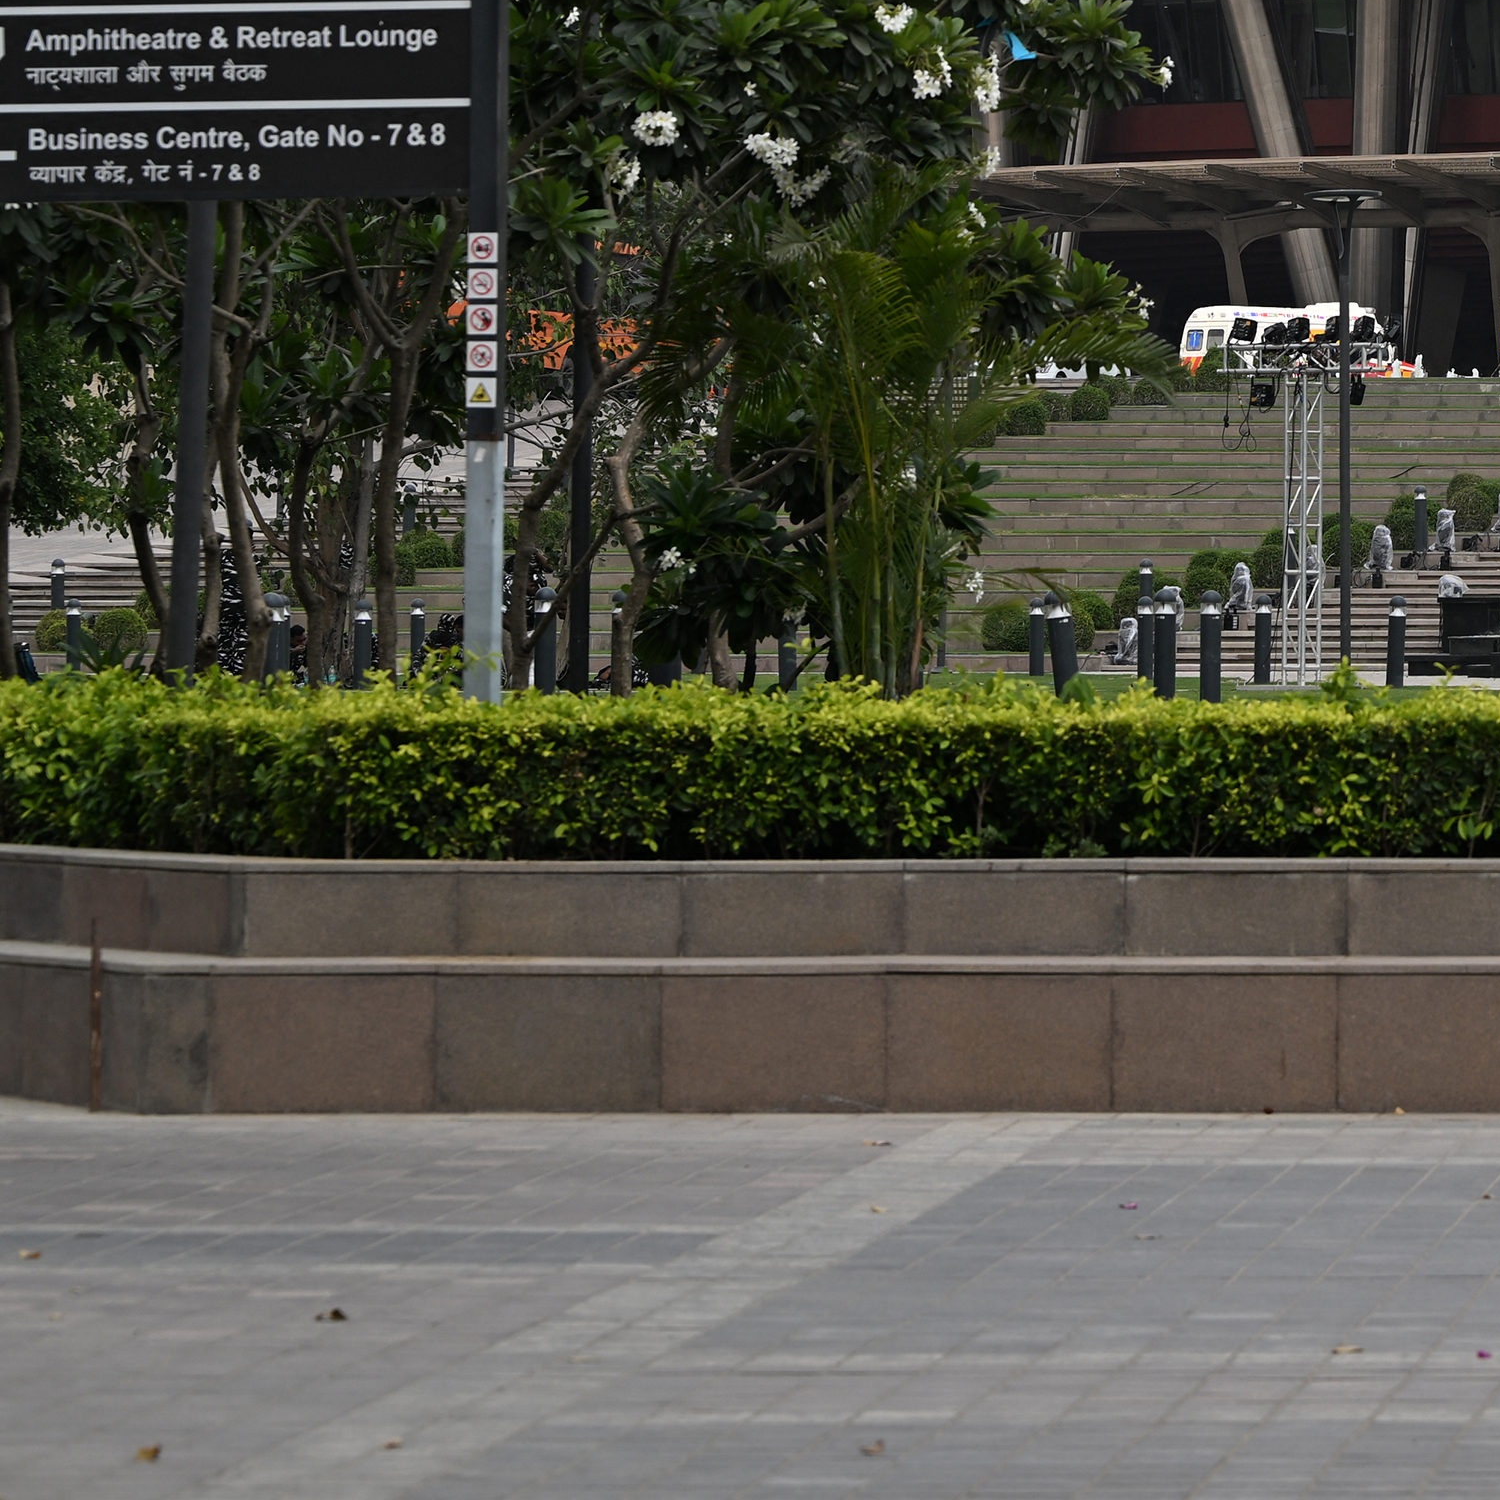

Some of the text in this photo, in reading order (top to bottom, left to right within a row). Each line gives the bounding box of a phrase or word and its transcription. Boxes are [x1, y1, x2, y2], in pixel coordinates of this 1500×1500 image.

[24, 24, 439, 57] Amphitheatre & Retreat Lounge
[125, 59, 163, 83] और
[168, 64, 216, 92] सुगम
[221, 58, 269, 82] बैठक
[28, 127, 150, 151] Business
[155, 125, 251, 152] Centre,
[257, 124, 320, 149] Gate
[327, 123, 365, 148] No
[28, 165, 88, 184] व्यापार
[140, 158, 172, 182] गेट
[176, 159, 194, 182] नं
